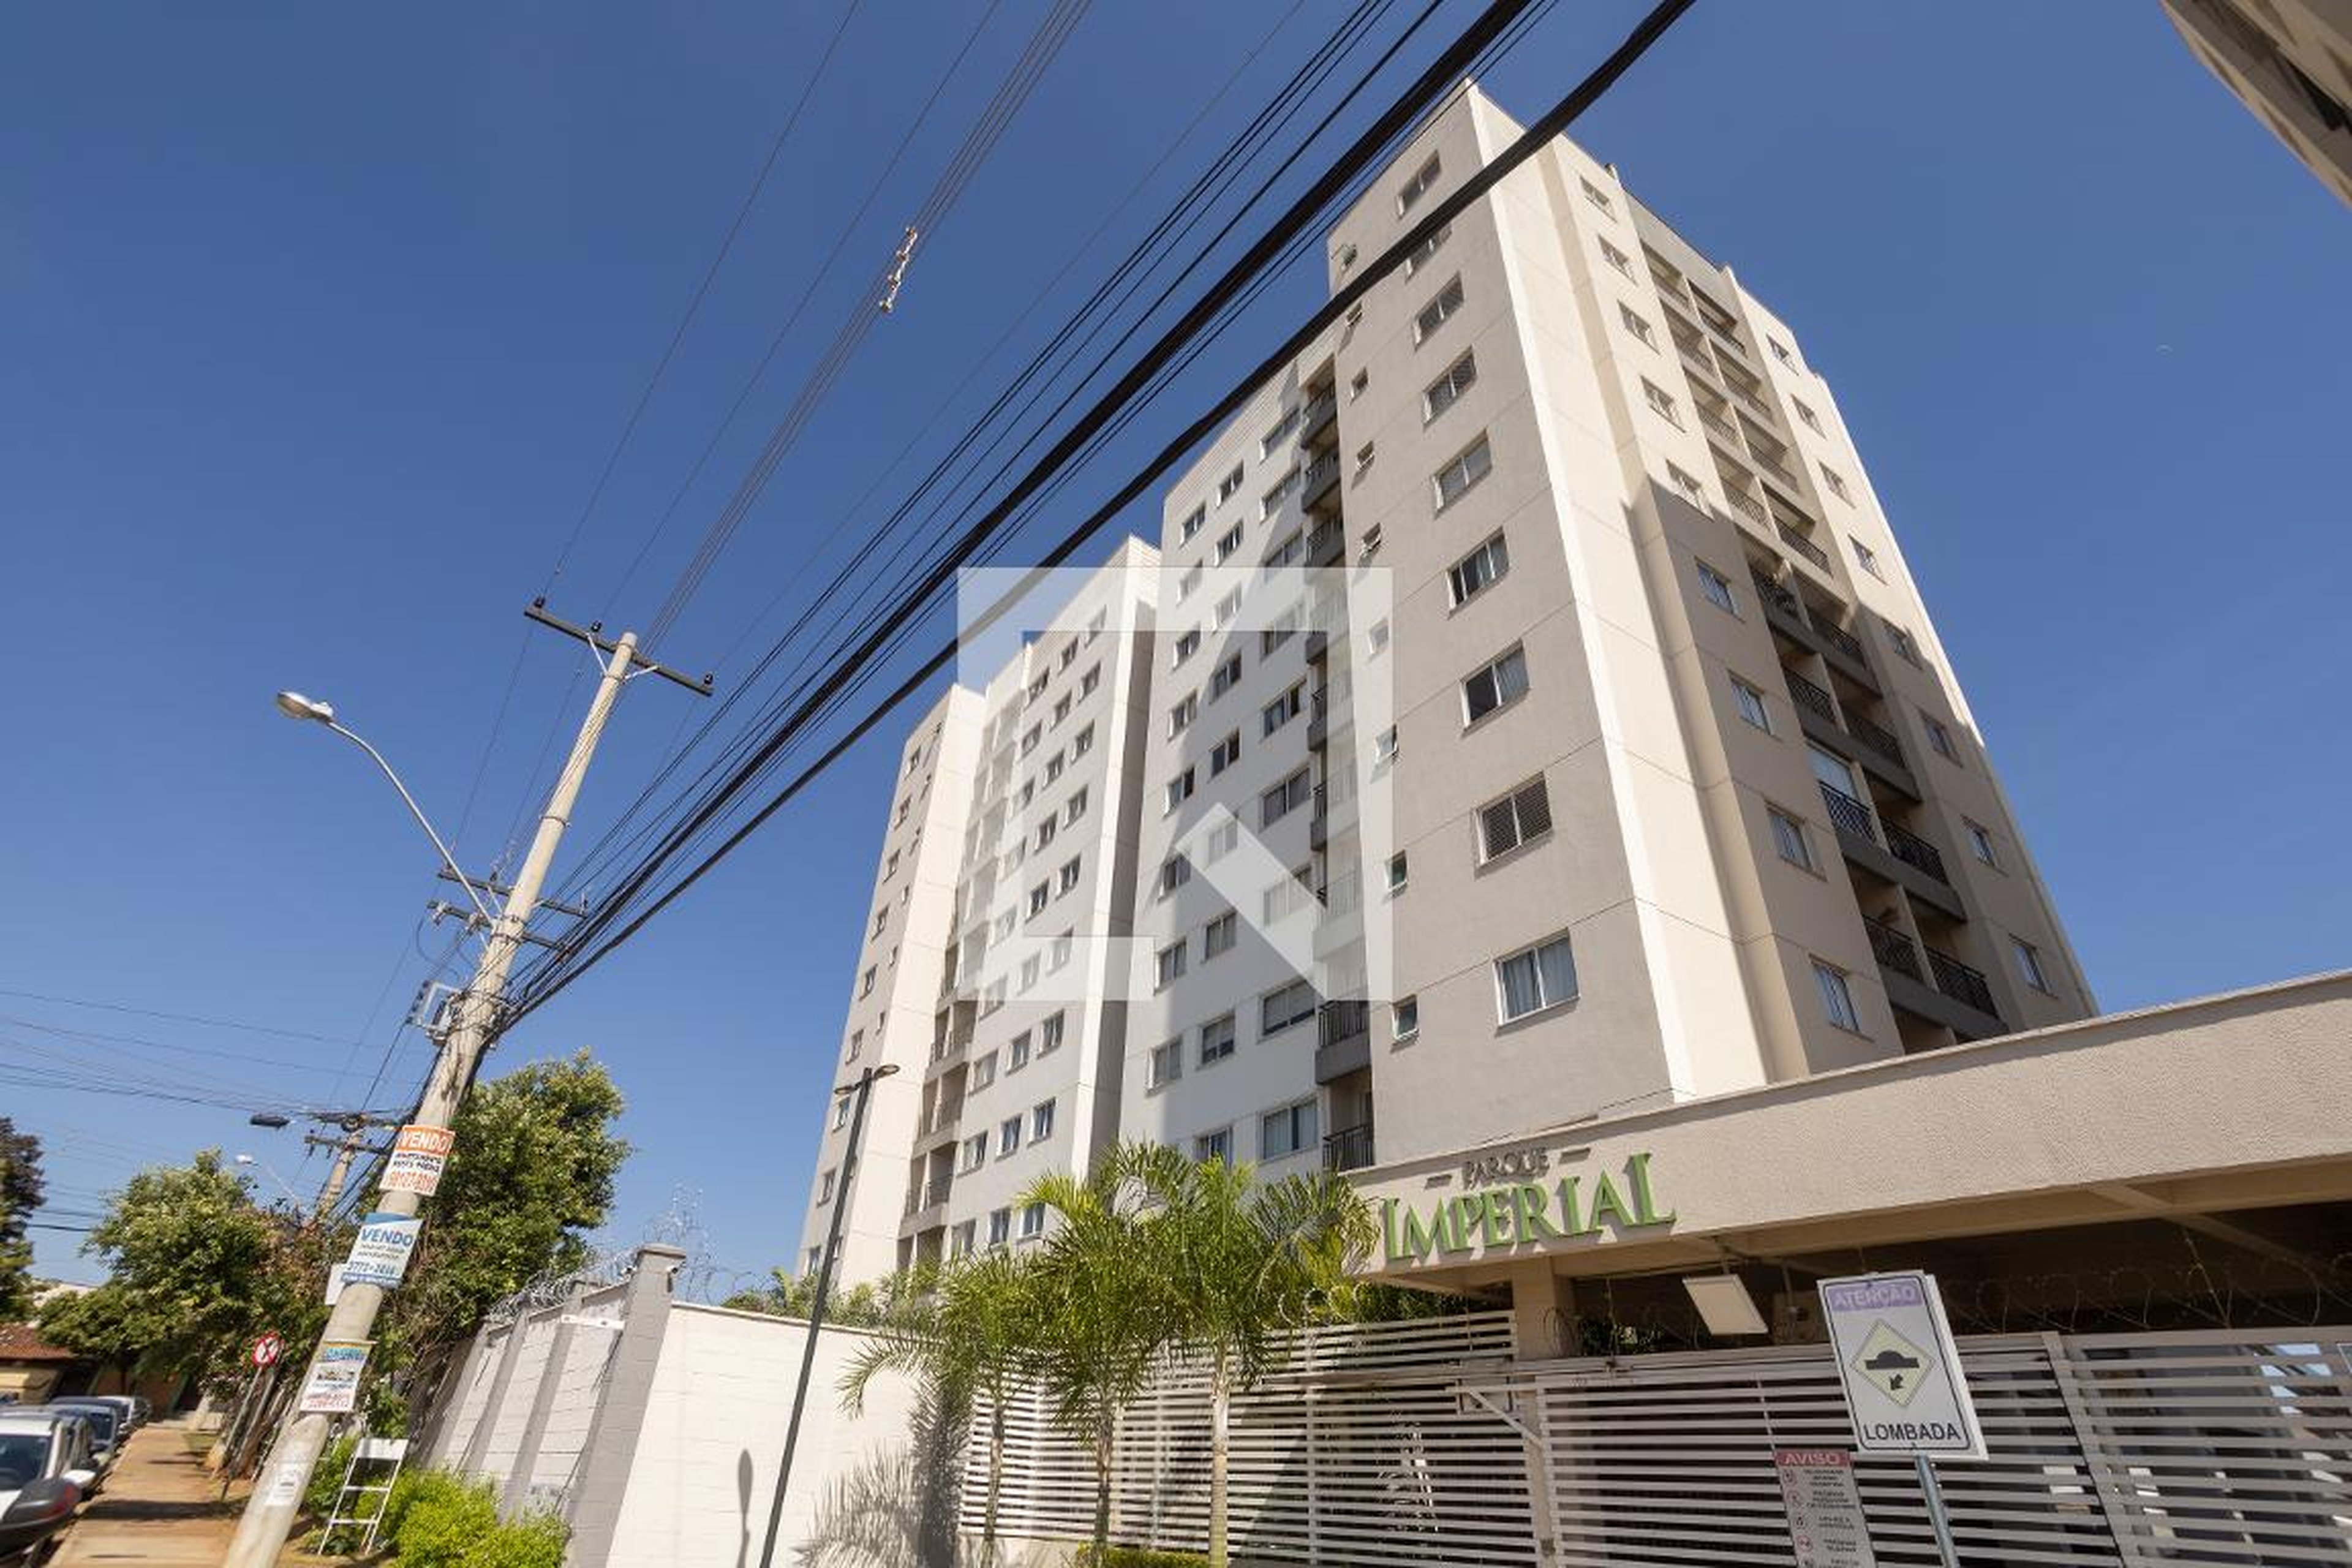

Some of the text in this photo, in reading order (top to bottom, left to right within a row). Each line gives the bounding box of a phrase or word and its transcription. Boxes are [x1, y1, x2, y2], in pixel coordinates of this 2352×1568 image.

[402, 1131, 450, 1152] VENDO
[1467, 1148, 1550, 1183] PARQUE
[1384, 1152, 1676, 1259] IMPERIAL
[361, 1227, 413, 1246] VENDO
[1863, 1422, 1961, 1440] LOMBADA
[1785, 1452, 1840, 1464] AVISO
